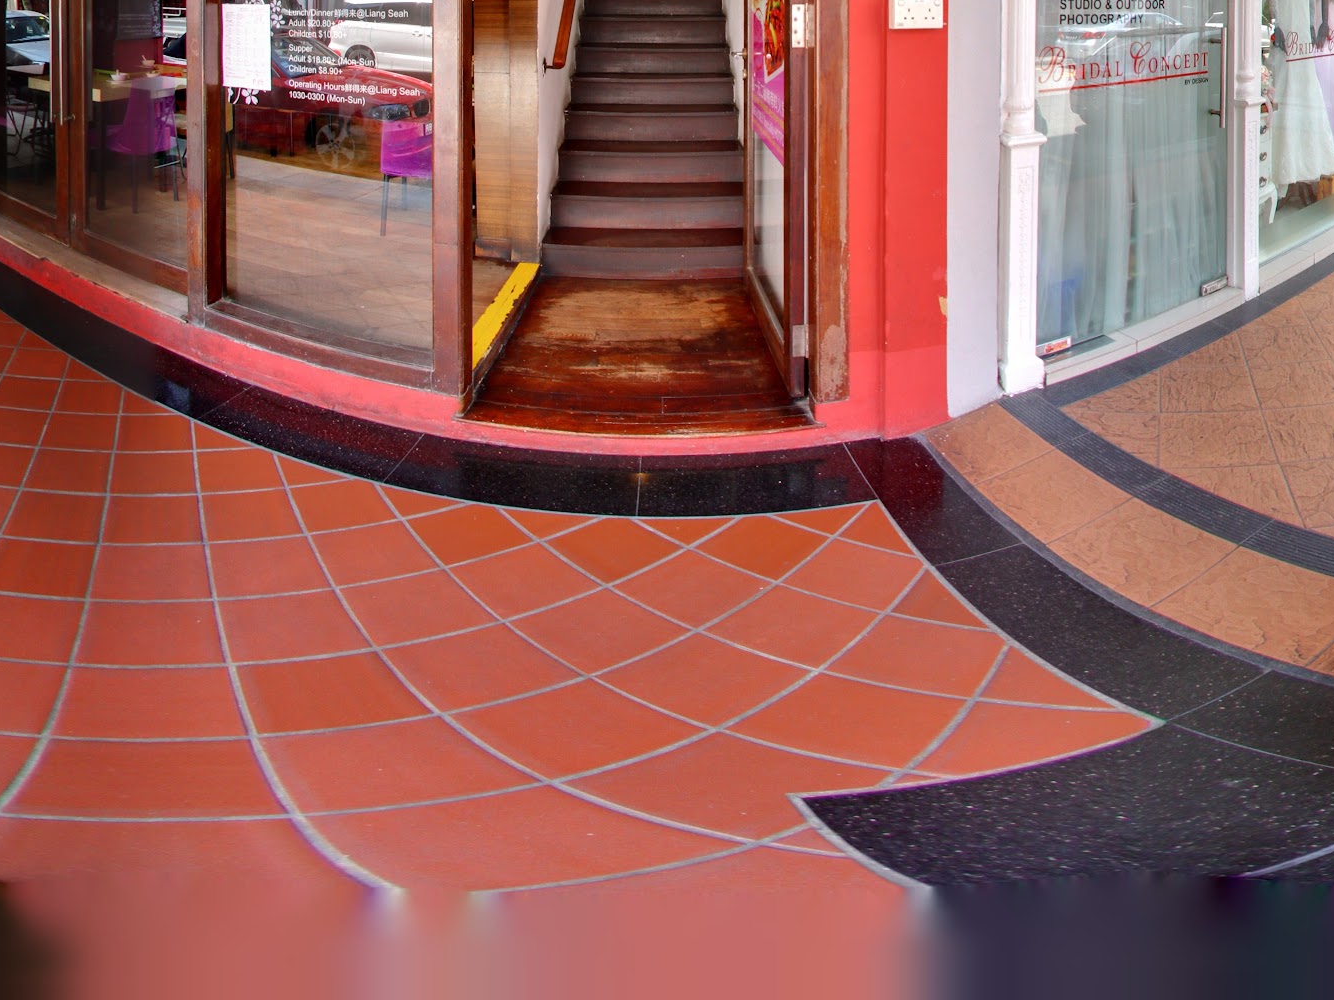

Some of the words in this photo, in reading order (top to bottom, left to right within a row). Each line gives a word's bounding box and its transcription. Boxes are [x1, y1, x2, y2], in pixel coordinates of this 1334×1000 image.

[1060, 0, 1102, 10] STUDIO
[1105, 0, 1112, 10] &
[1116, 0, 1165, 10] OUTDOOR
[387, 9, 408, 18] Seah
[288, 19, 306, 27] Adult
[307, 19, 336, 28] $20.80+
[1060, 14, 1144, 25] PHOTOGRAPHY
[288, 29, 317, 38] Children
[288, 44, 313, 53] Supper
[288, 54, 306, 63] Adult
[338, 56, 378, 68] (Mon-Sun)
[1129, 41, 1209, 75] CONCEPT
[288, 64, 317, 74] Children
[319, 66, 343, 76] $8.90+
[1192, 77, 1209, 85] DESIGN
[288, 79, 322, 92] Operating
[399, 87, 421, 97] Seah
[289, 91, 325, 102] 1030-0300
[326, 93, 366, 106] (Mon-Sun)
